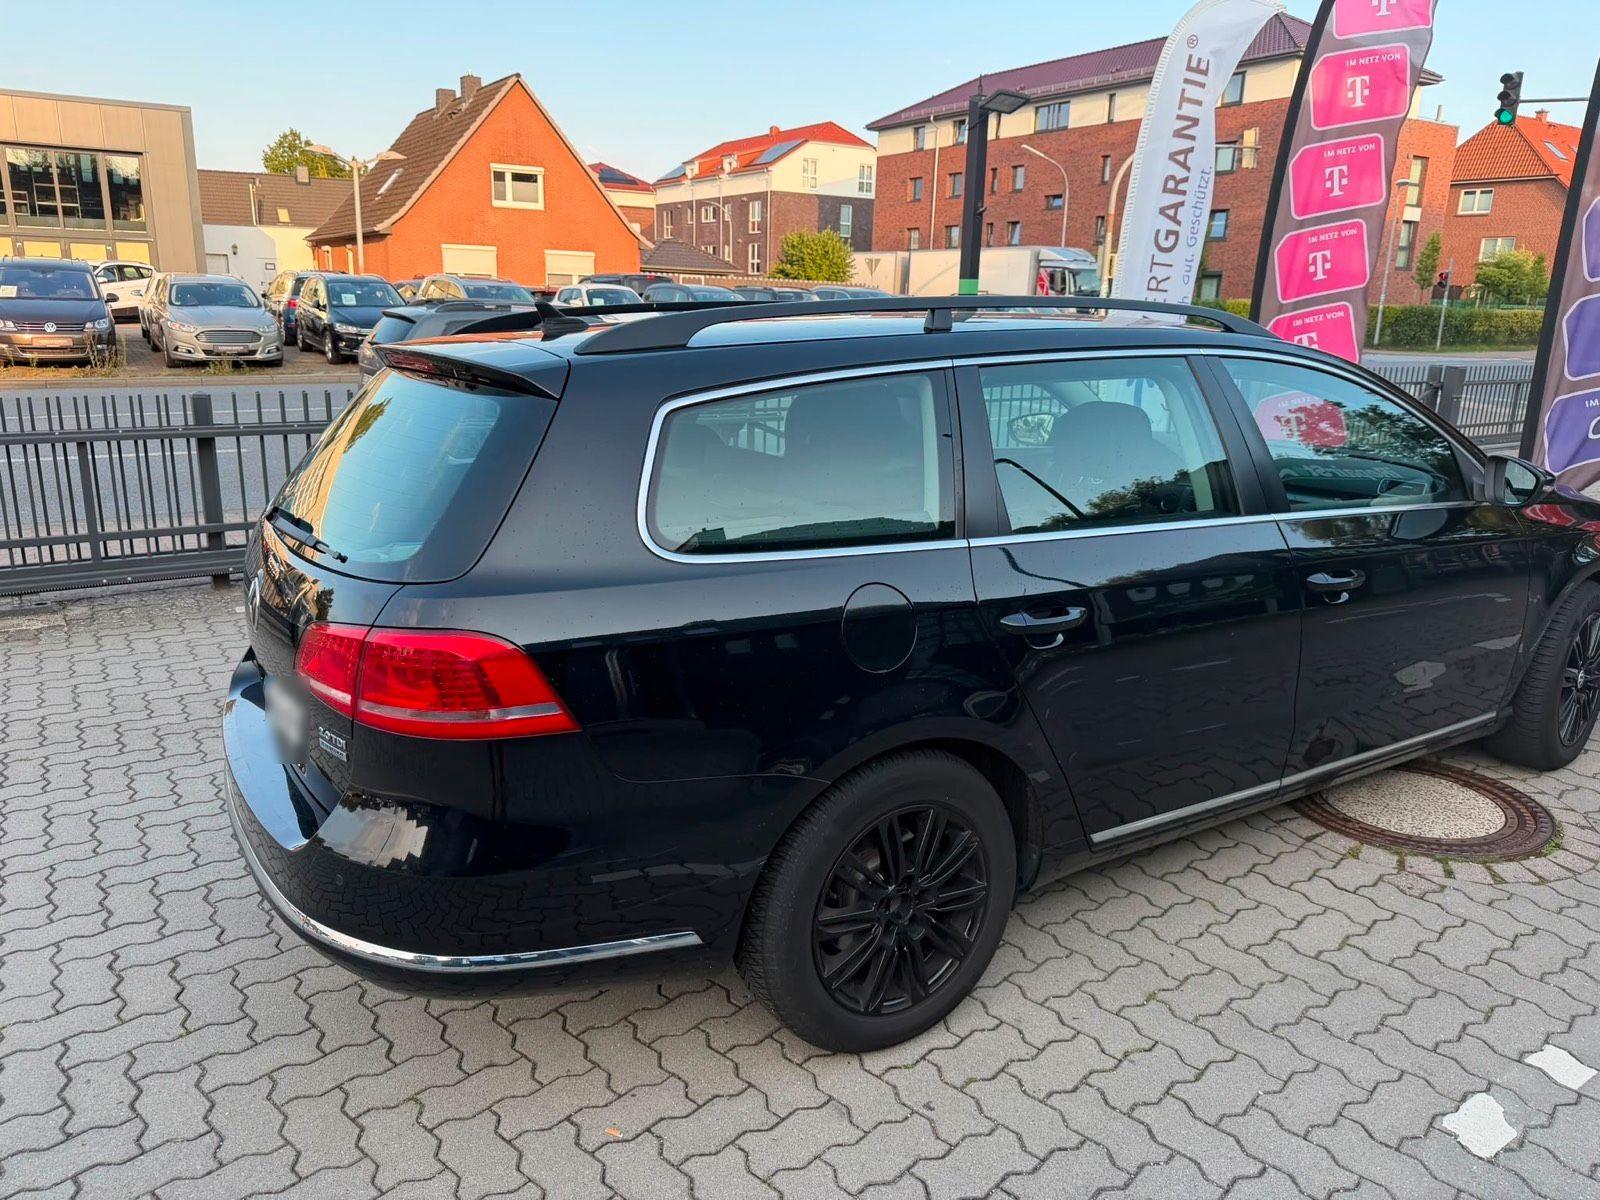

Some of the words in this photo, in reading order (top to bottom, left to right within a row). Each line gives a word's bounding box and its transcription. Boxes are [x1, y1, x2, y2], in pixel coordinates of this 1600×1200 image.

[1346, 58, 1357, 67] IM
[1359, 55, 1380, 66] NETZ
[1381, 53, 1401, 62] VON
[1324, 150, 1335, 158] IM
[1336, 146, 1357, 155] NETZ
[1358, 143, 1376, 152] VON
[1186, 165, 1212, 248] Geschützt.
[1308, 236, 1318, 244] IM
[1319, 231, 1340, 241] NETZ
[1340, 228, 1357, 237] VON
[1292, 319, 1303, 327] IM
[1304, 313, 1325, 324] NETZ
[1325, 310, 1345, 320] VON
